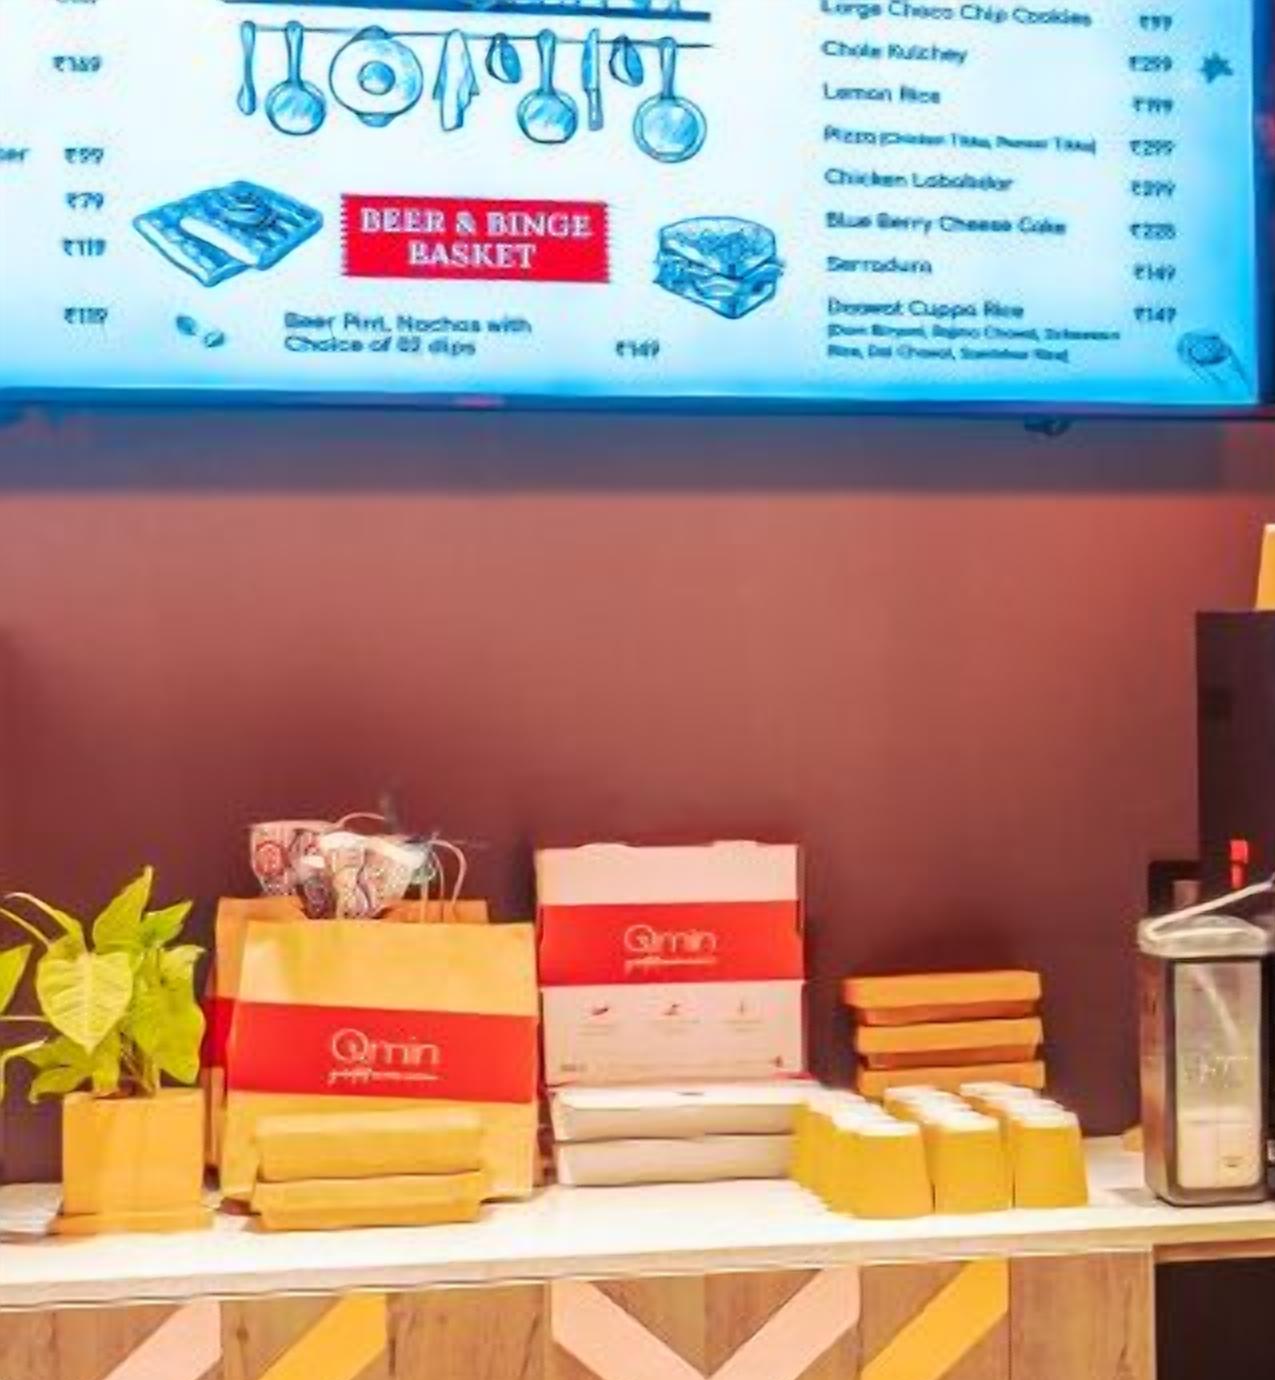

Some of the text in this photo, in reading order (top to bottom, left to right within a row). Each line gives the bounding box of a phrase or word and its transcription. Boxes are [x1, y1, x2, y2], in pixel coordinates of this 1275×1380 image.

[959, 4, 1009, 24] Chip
[1011, 7, 1093, 27] Cookies
[821, 40, 883, 59] Chole
[823, 83, 941, 104] Lemon Rice
[823, 125, 877, 145] Pizza
[824, 167, 908, 188] Chicken
[361, 207, 592, 238] BEER & BINGE
[825, 211, 1067, 235] Blue Berry Cheese Cake
[409, 240, 536, 269] BASKET
[982, 301, 1025, 320] Rice
[284, 312, 335, 330] Beer
[396, 315, 481, 334] Nachos
[486, 318, 532, 334] with
[284, 335, 365, 353] Choice
[369, 336, 392, 353] of
[427, 337, 477, 357] dips
[329, 1025, 442, 1068] Qmin
